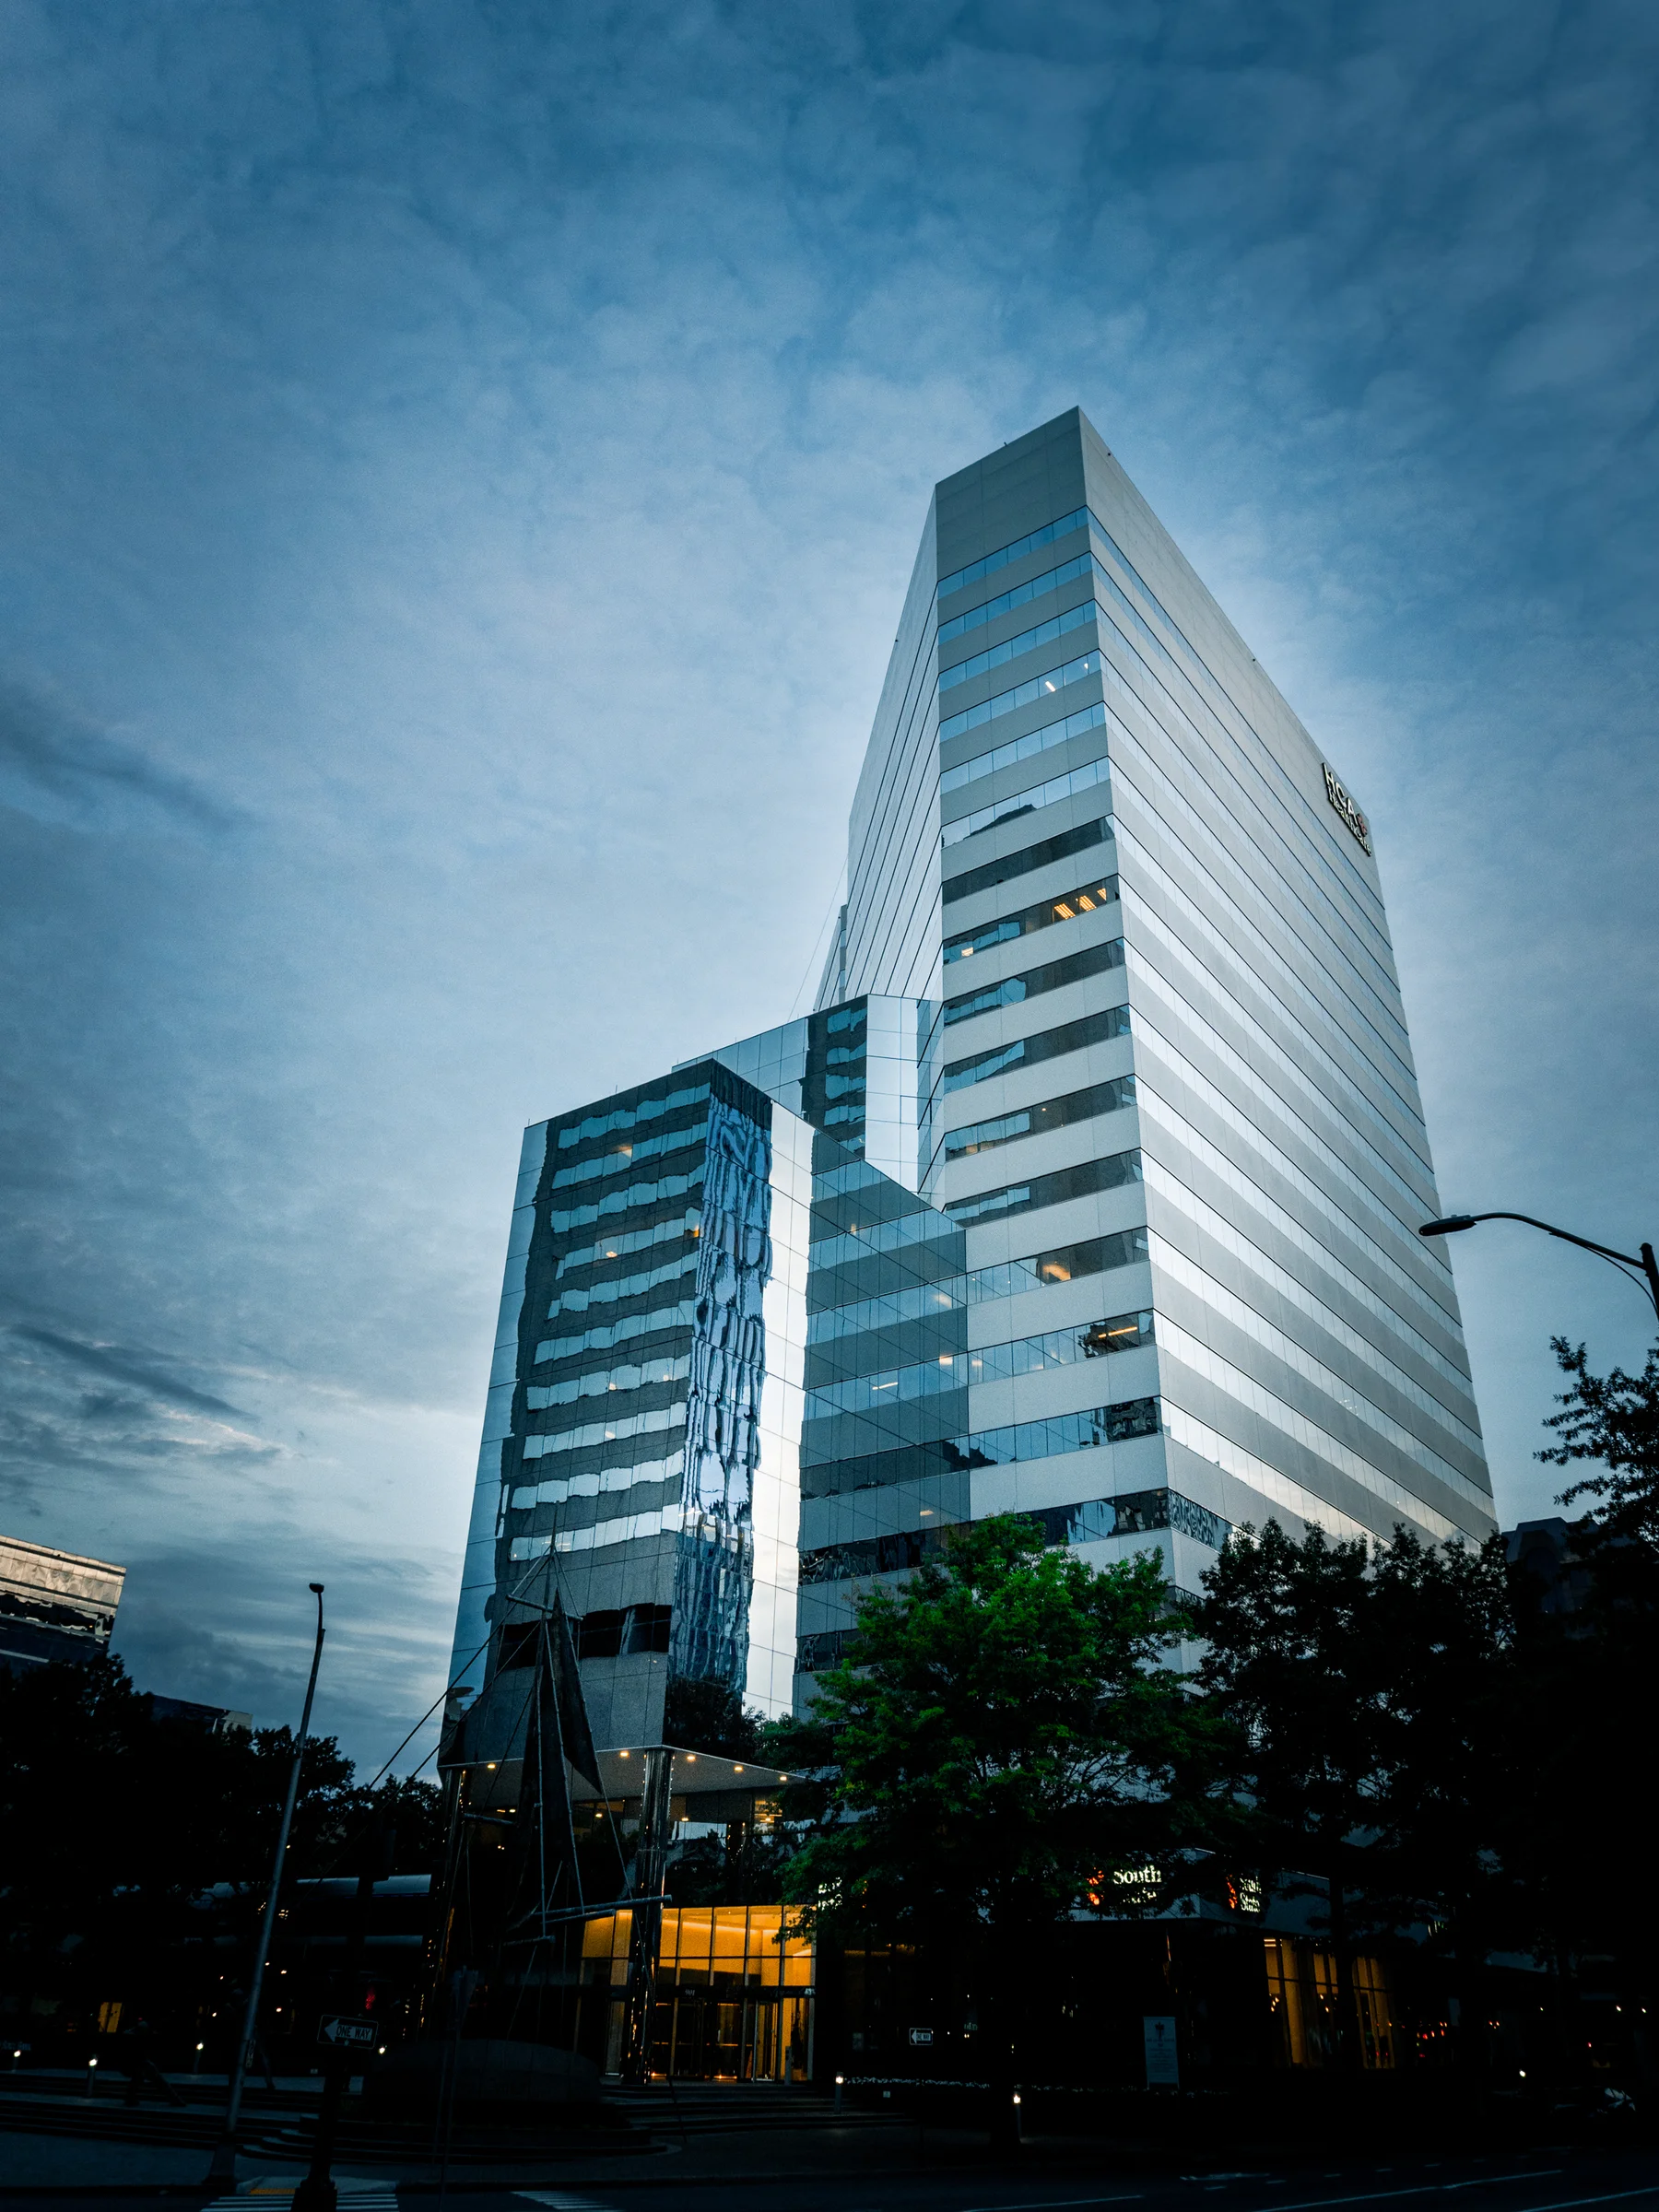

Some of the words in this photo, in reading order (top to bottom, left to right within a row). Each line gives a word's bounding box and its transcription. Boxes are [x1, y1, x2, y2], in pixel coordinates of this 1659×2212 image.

[1322, 762, 1359, 828] HCA
[1113, 1864, 1162, 1885] South
[336, 2026, 351, 2037] ONE
[355, 2028, 371, 2039] WAY
